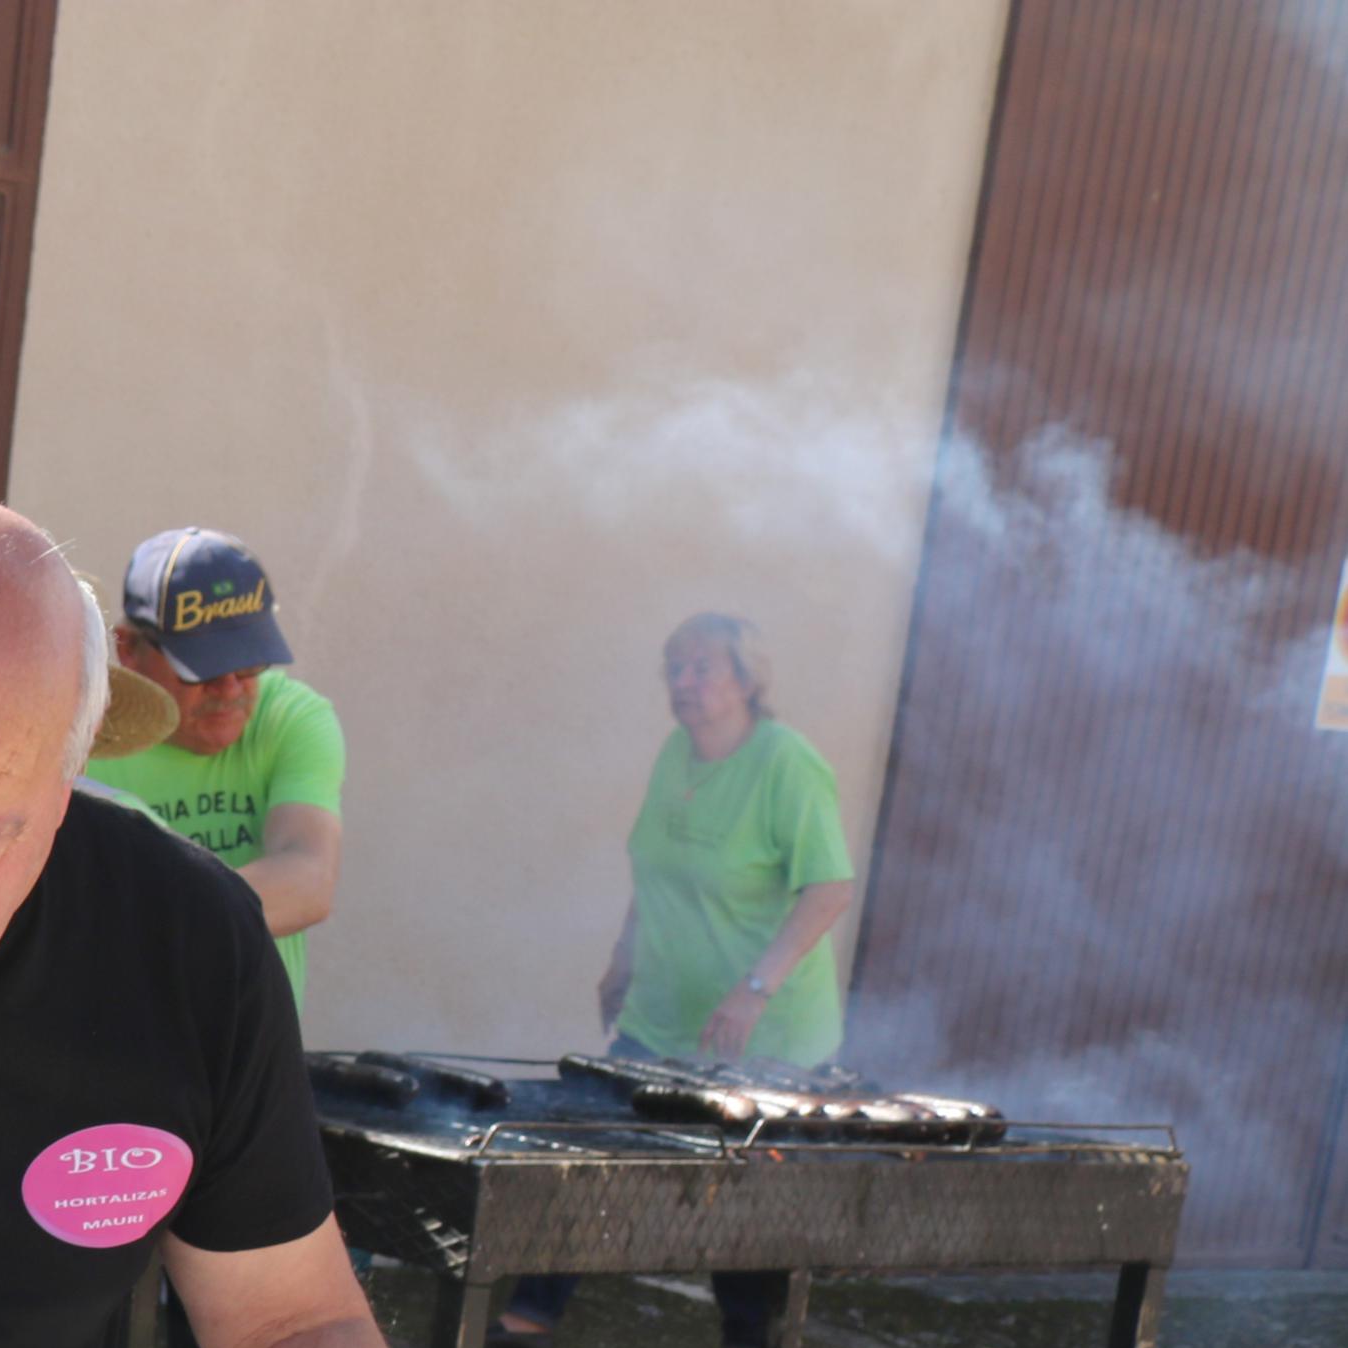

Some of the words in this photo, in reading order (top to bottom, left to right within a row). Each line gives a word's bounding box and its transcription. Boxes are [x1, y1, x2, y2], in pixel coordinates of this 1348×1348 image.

[197, 791, 226, 816] DE
[231, 792, 256, 815] LA
[59, 1147, 163, 1174] BIO
[55, 1188, 168, 1209] HORTALIZAS
[83, 1214, 145, 1231] MAURI
